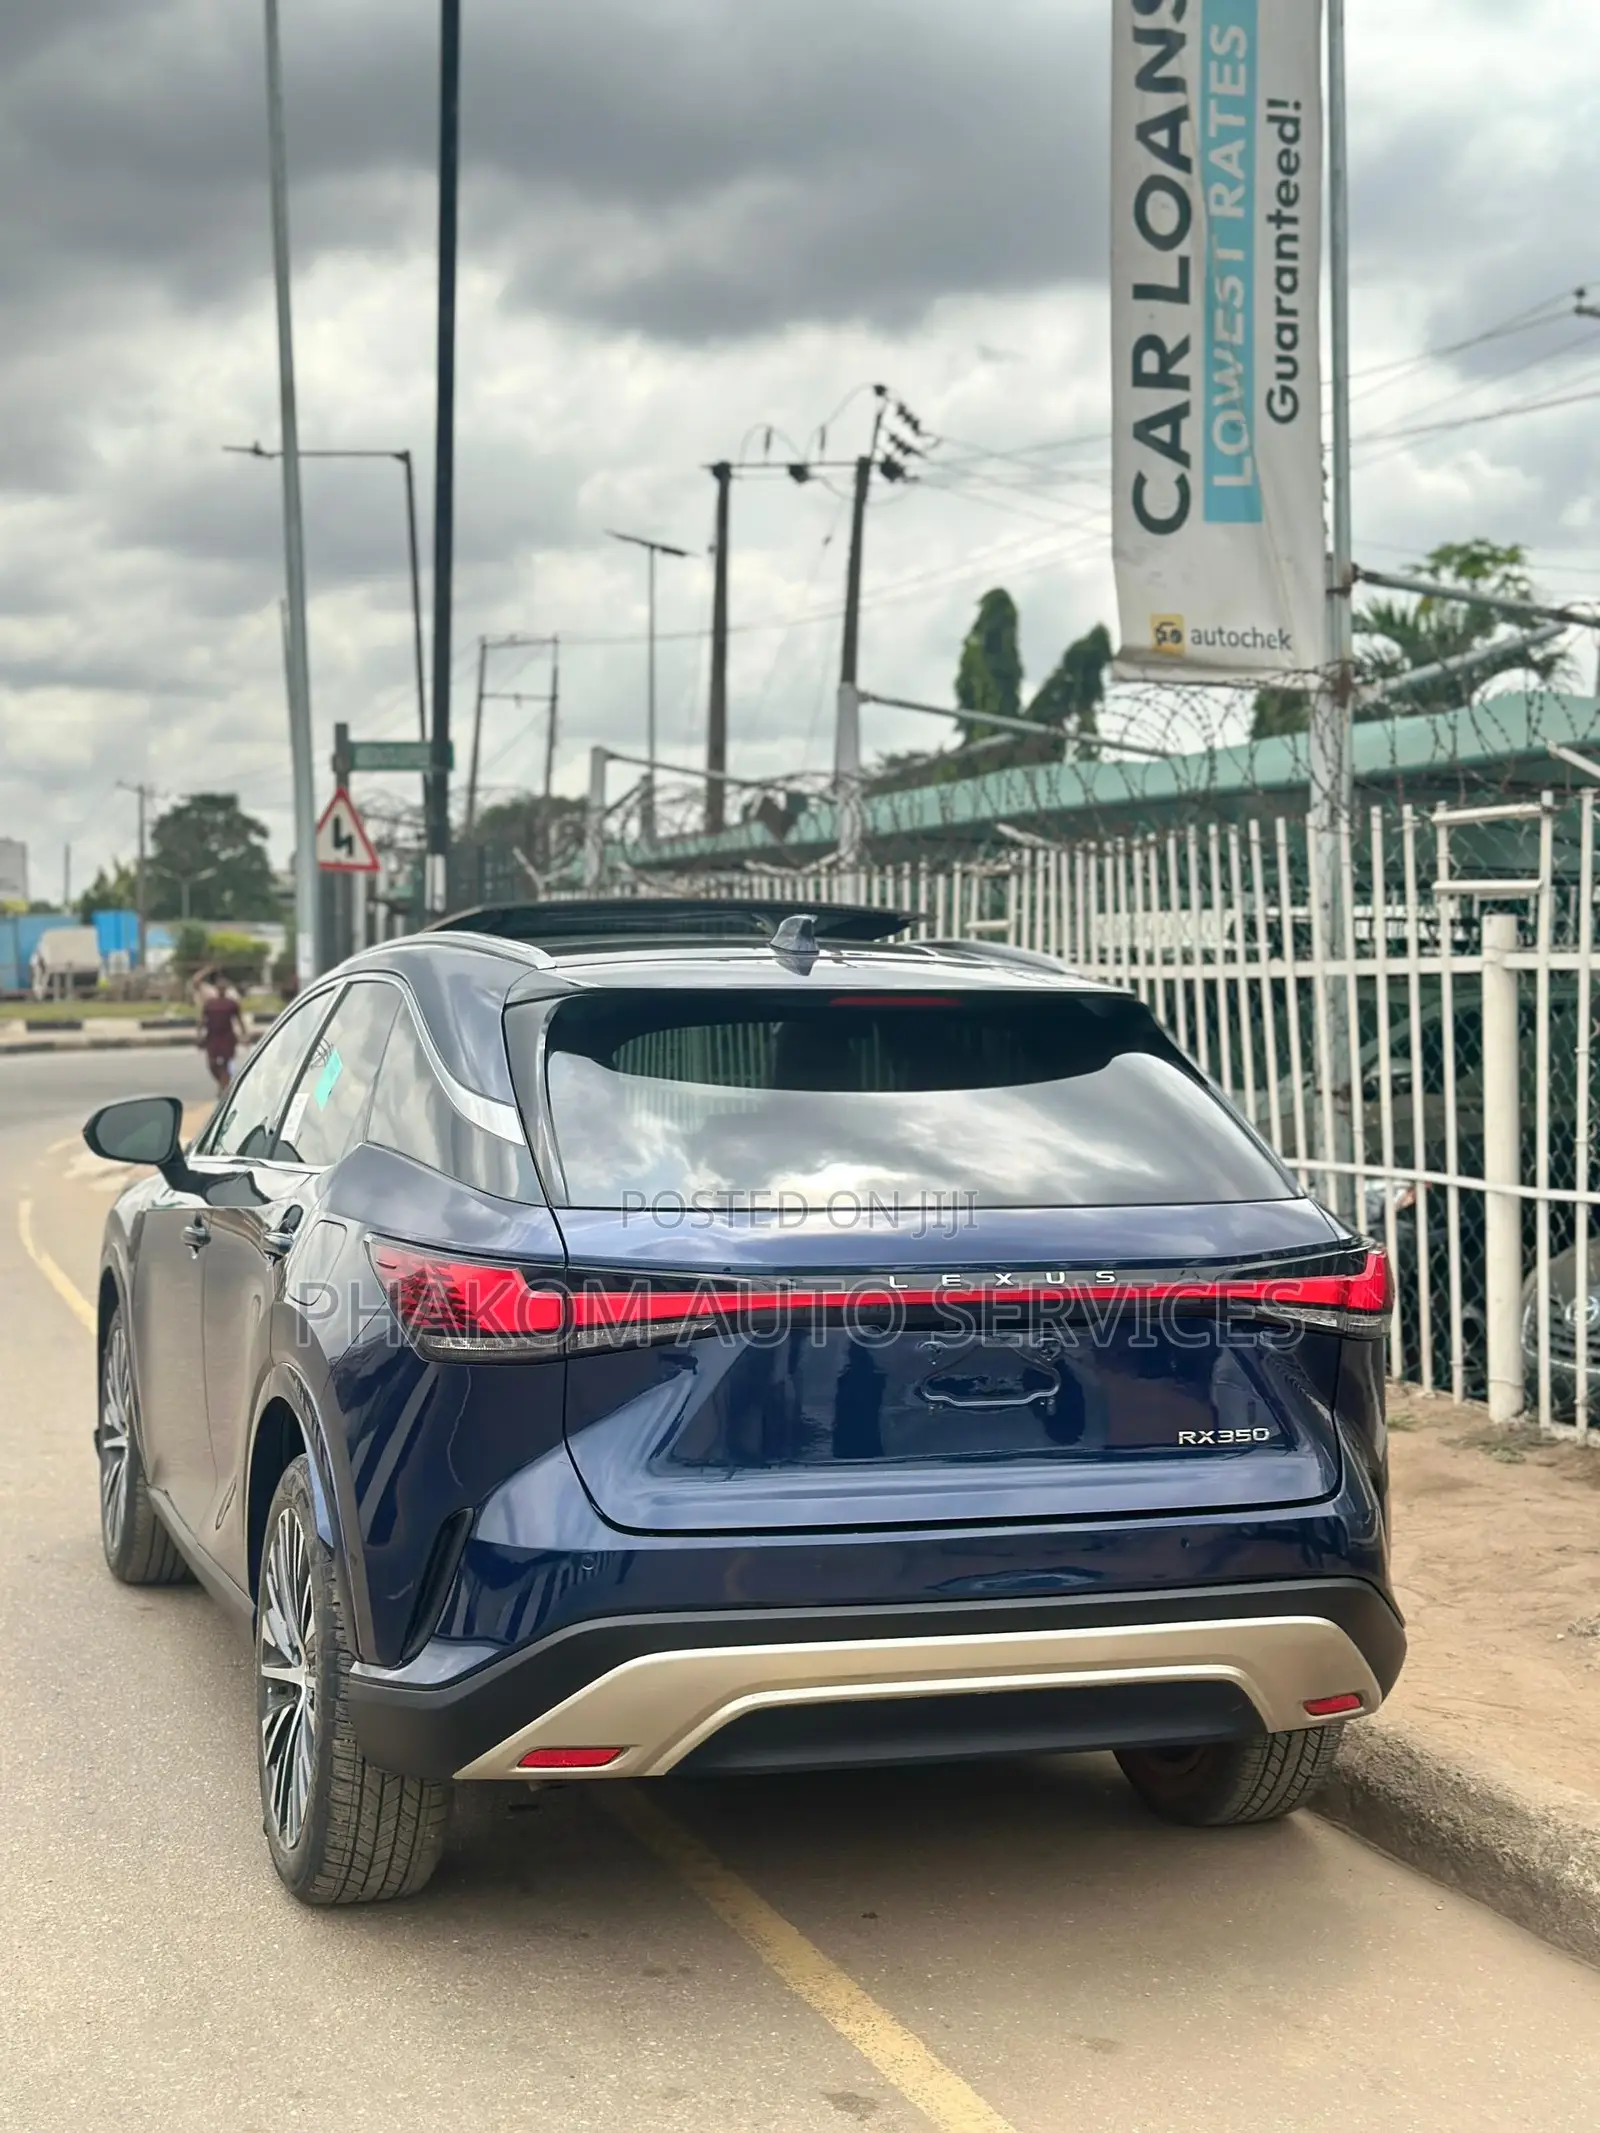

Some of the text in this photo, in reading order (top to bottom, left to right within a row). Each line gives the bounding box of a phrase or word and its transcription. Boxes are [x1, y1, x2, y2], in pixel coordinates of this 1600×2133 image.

[1208, 24, 1254, 488] LOWEST RATES
[1265, 97, 1302, 425] Guaranteed!
[1132, 333, 1192, 536] CAR
[1191, 625, 1293, 651] autochek
[888, 1269, 1117, 1290] LEXUS
[1177, 1427, 1270, 1446] RX350
